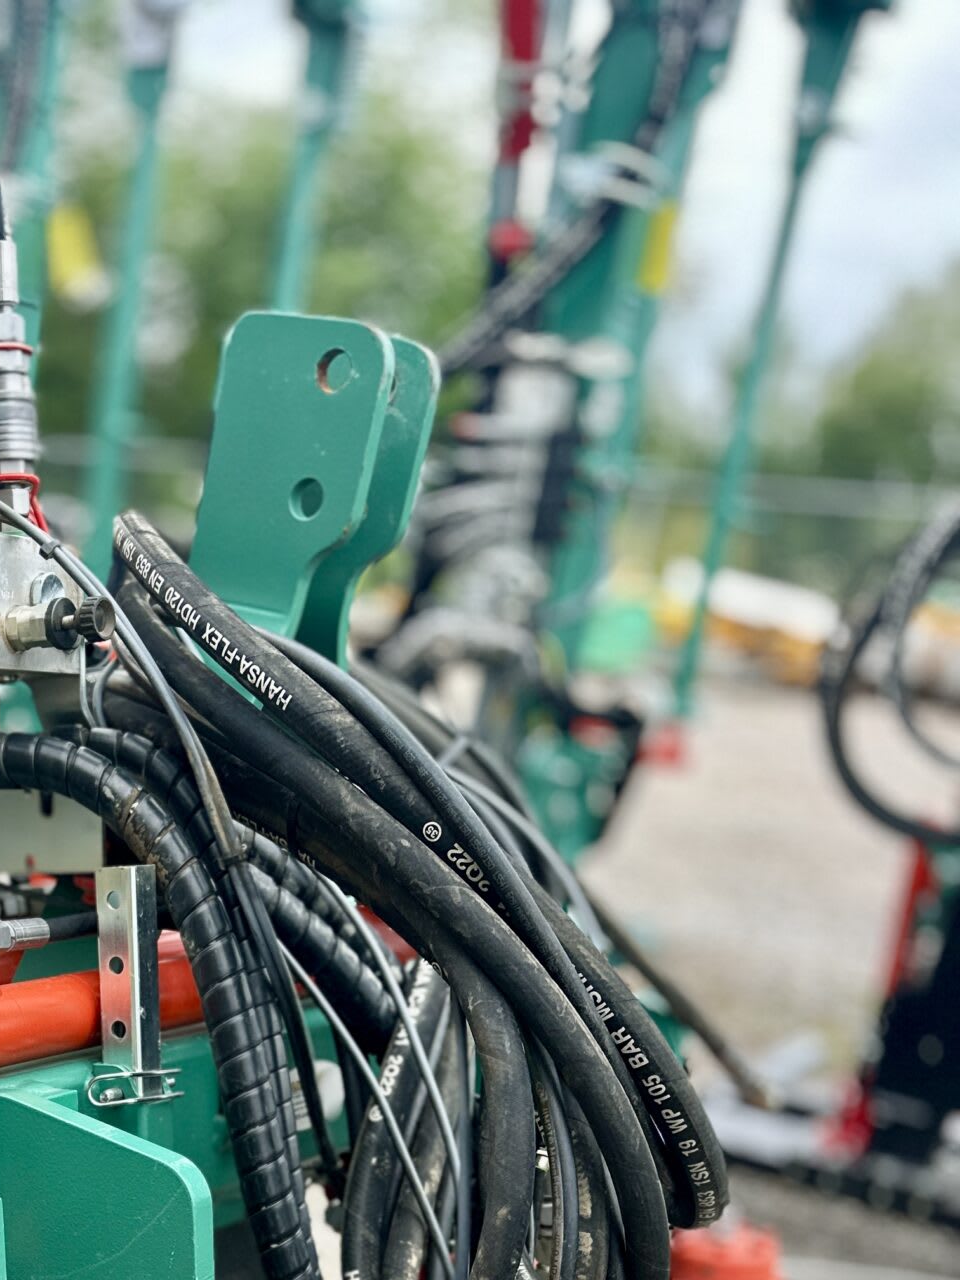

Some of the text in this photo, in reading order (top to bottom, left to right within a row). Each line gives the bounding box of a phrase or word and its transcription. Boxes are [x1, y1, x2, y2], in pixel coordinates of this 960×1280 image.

[122, 539, 136, 562] 1SN
[135, 553, 151, 583] 853
[148, 570, 165, 593] EN
[164, 587, 201, 630] HD120
[202, 622, 293, 711] HANSA-FLEX
[447, 843, 490, 892] 2Q22
[610, 1026, 650, 1069] BAR
[642, 1074, 672, 1106] 105
[661, 1108, 688, 1135] WP
[678, 1138, 700, 1157] 19
[687, 1161, 711, 1187] 1SN
[696, 1190, 717, 1205] 853
